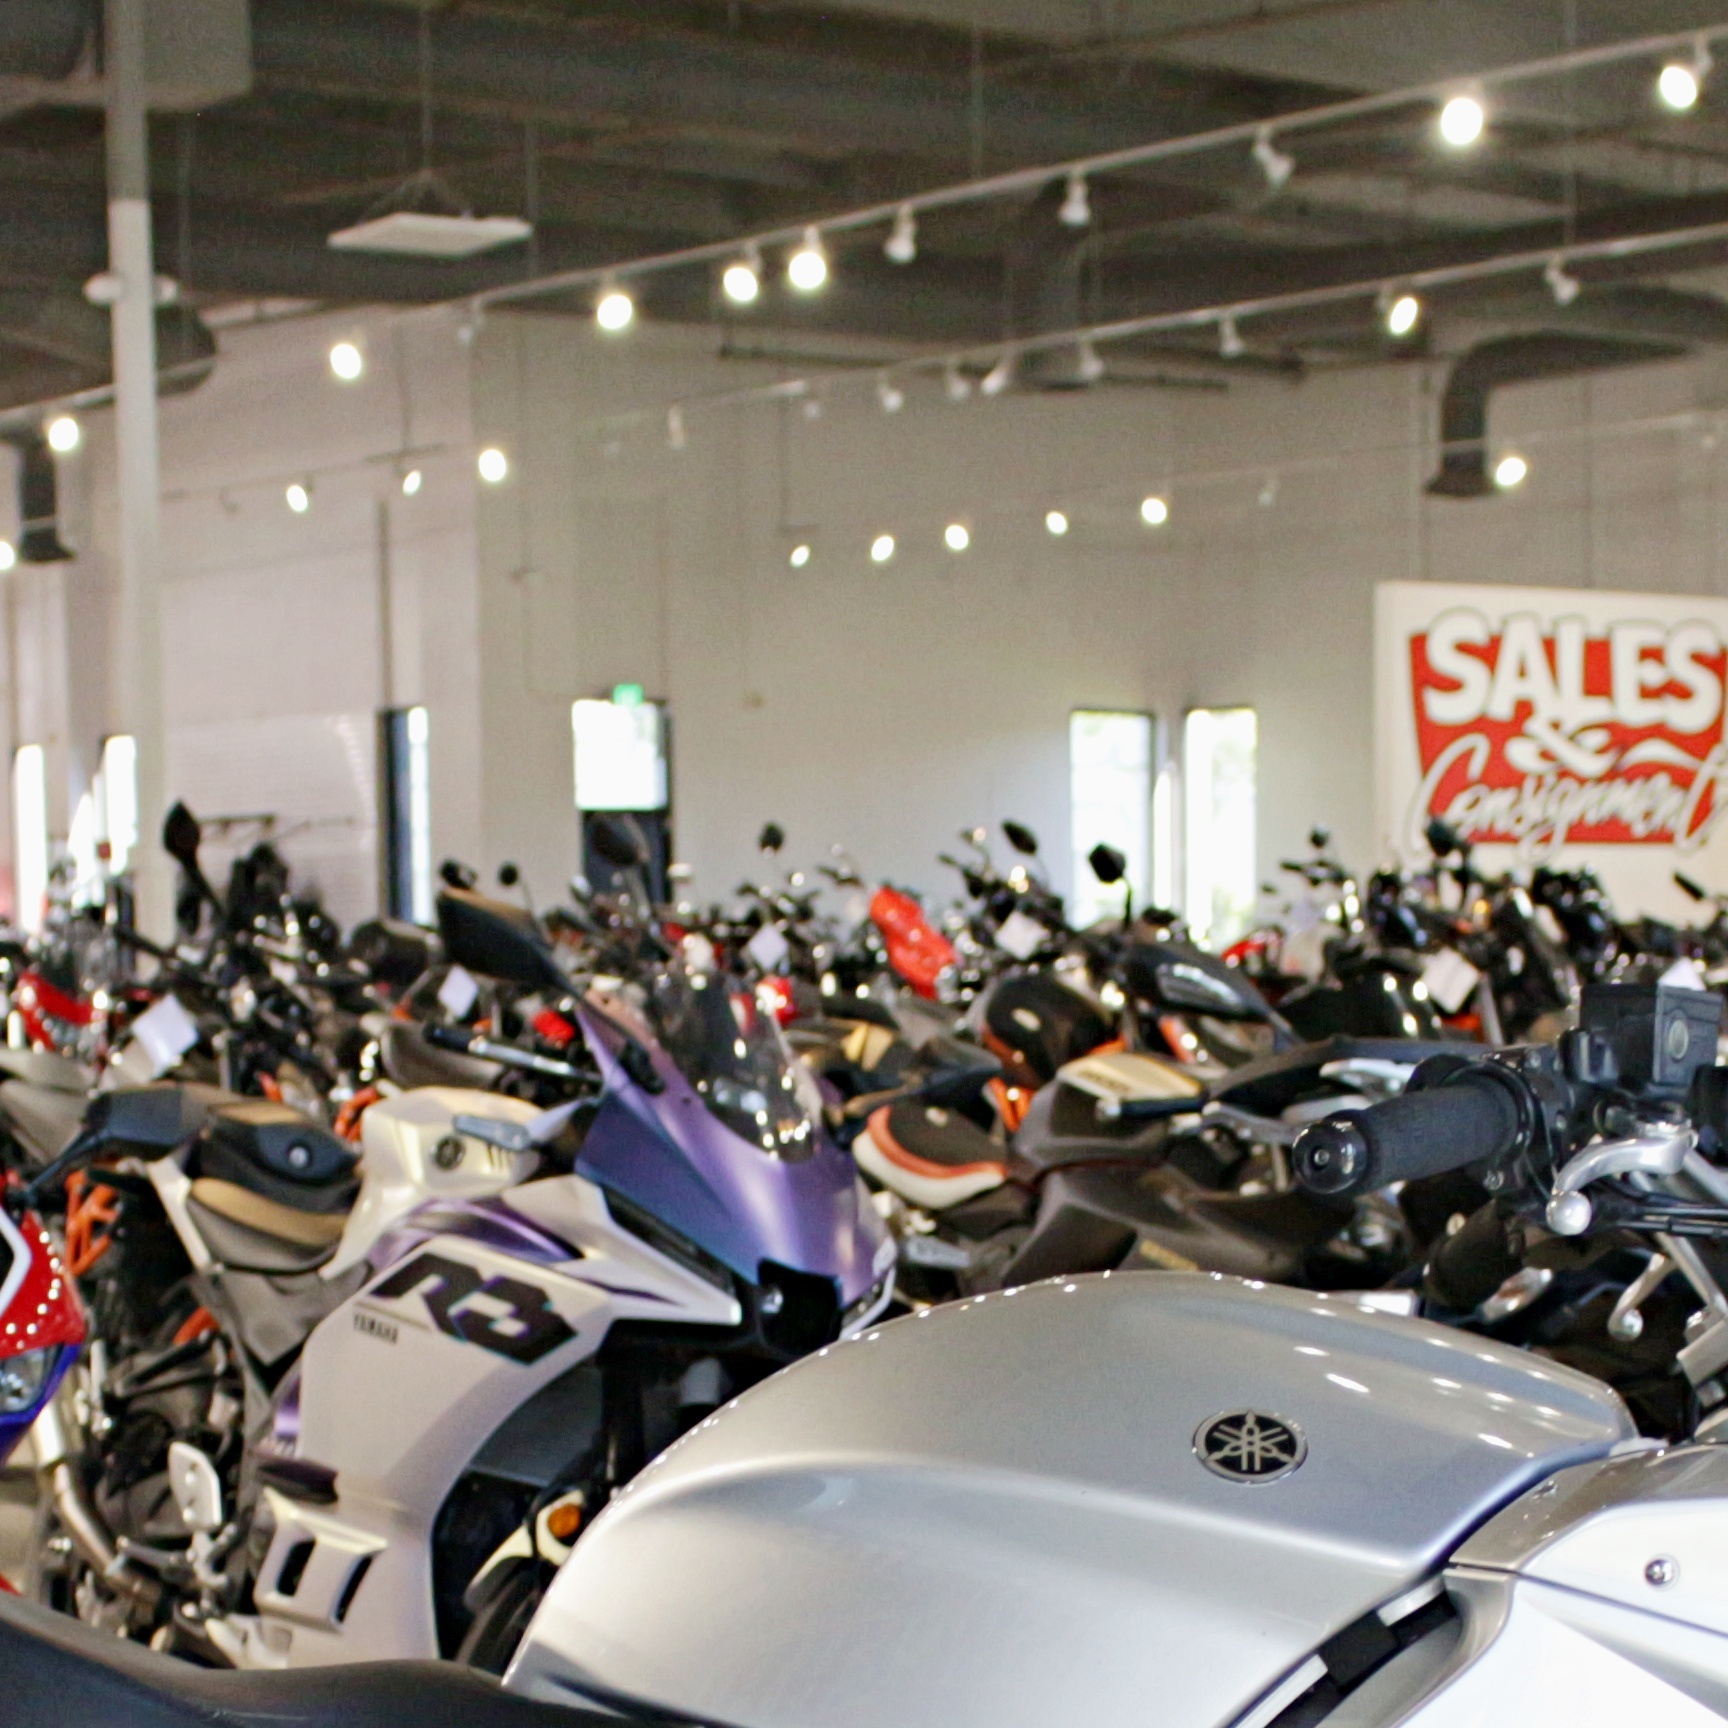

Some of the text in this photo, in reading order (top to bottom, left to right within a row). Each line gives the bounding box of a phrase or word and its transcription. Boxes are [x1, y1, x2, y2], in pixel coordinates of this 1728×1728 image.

[1422, 606, 1724, 734] SALES
[1504, 716, 1621, 781] &
[353, 1313, 400, 1345] YAMAHA
[369, 1251, 579, 1366] R3
